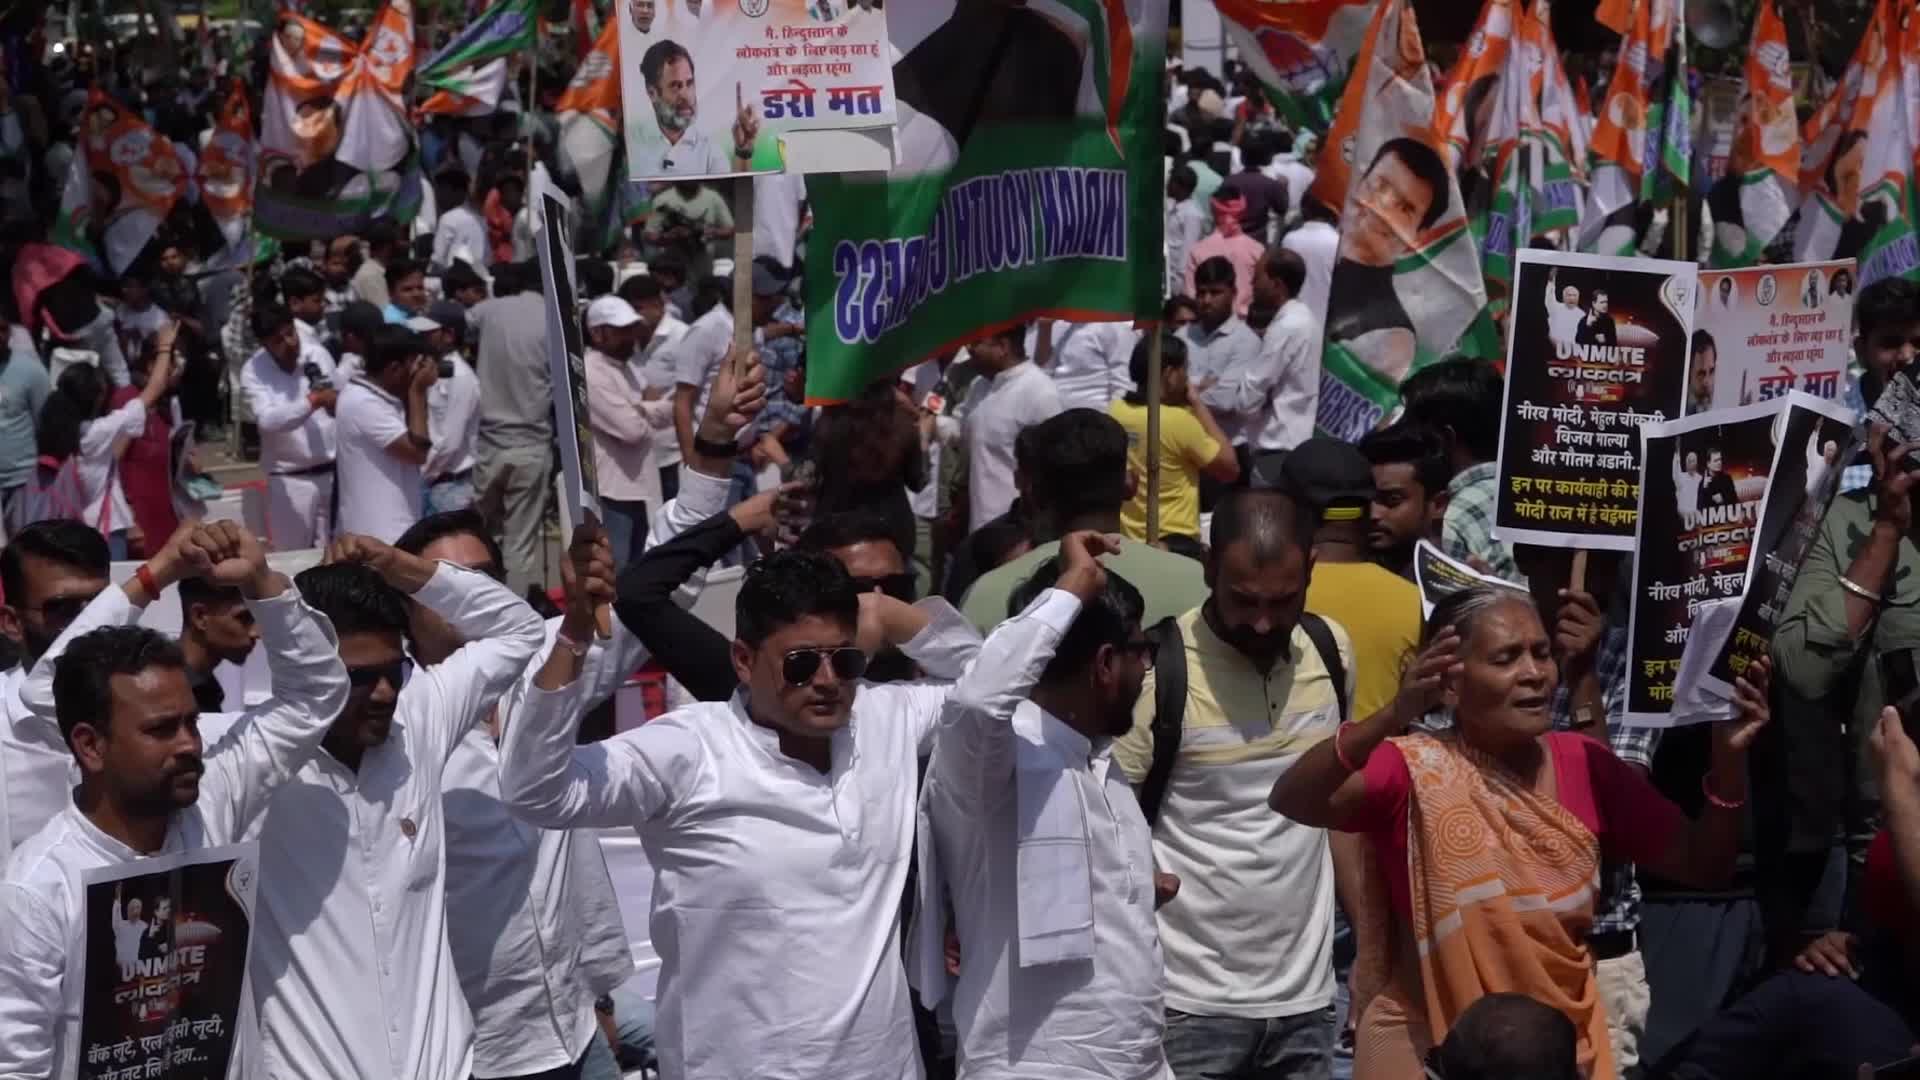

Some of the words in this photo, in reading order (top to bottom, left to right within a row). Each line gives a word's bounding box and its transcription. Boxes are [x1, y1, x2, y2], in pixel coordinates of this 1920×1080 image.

[760, 79, 816, 119] डरो
[826, 85, 883, 115] मत
[1556, 344, 1645, 365] UNMUTE
[1517, 400, 1548, 421] नीरव
[1552, 403, 1586, 427] मोदी,
[1590, 406, 1616, 430] मेहुल
[1556, 425, 1593, 446] विजय
[1596, 431, 1629, 448] माल्या
[1531, 443, 1557, 465] और
[1560, 446, 1595, 468] गौतम
[1511, 476, 1531, 493] इन
[1536, 479, 1553, 494] पर
[1611, 483, 1629, 498] की
[1515, 498, 1545, 519] मोदी
[1549, 506, 1573, 521] राज
[1648, 581, 1680, 601] नीरव
[1712, 570, 1745, 595] मेहुल
[1644, 659, 1665, 675] इन
[88, 1043, 112, 1065] बैंक
[192, 1013, 225, 1041] लूटी,
